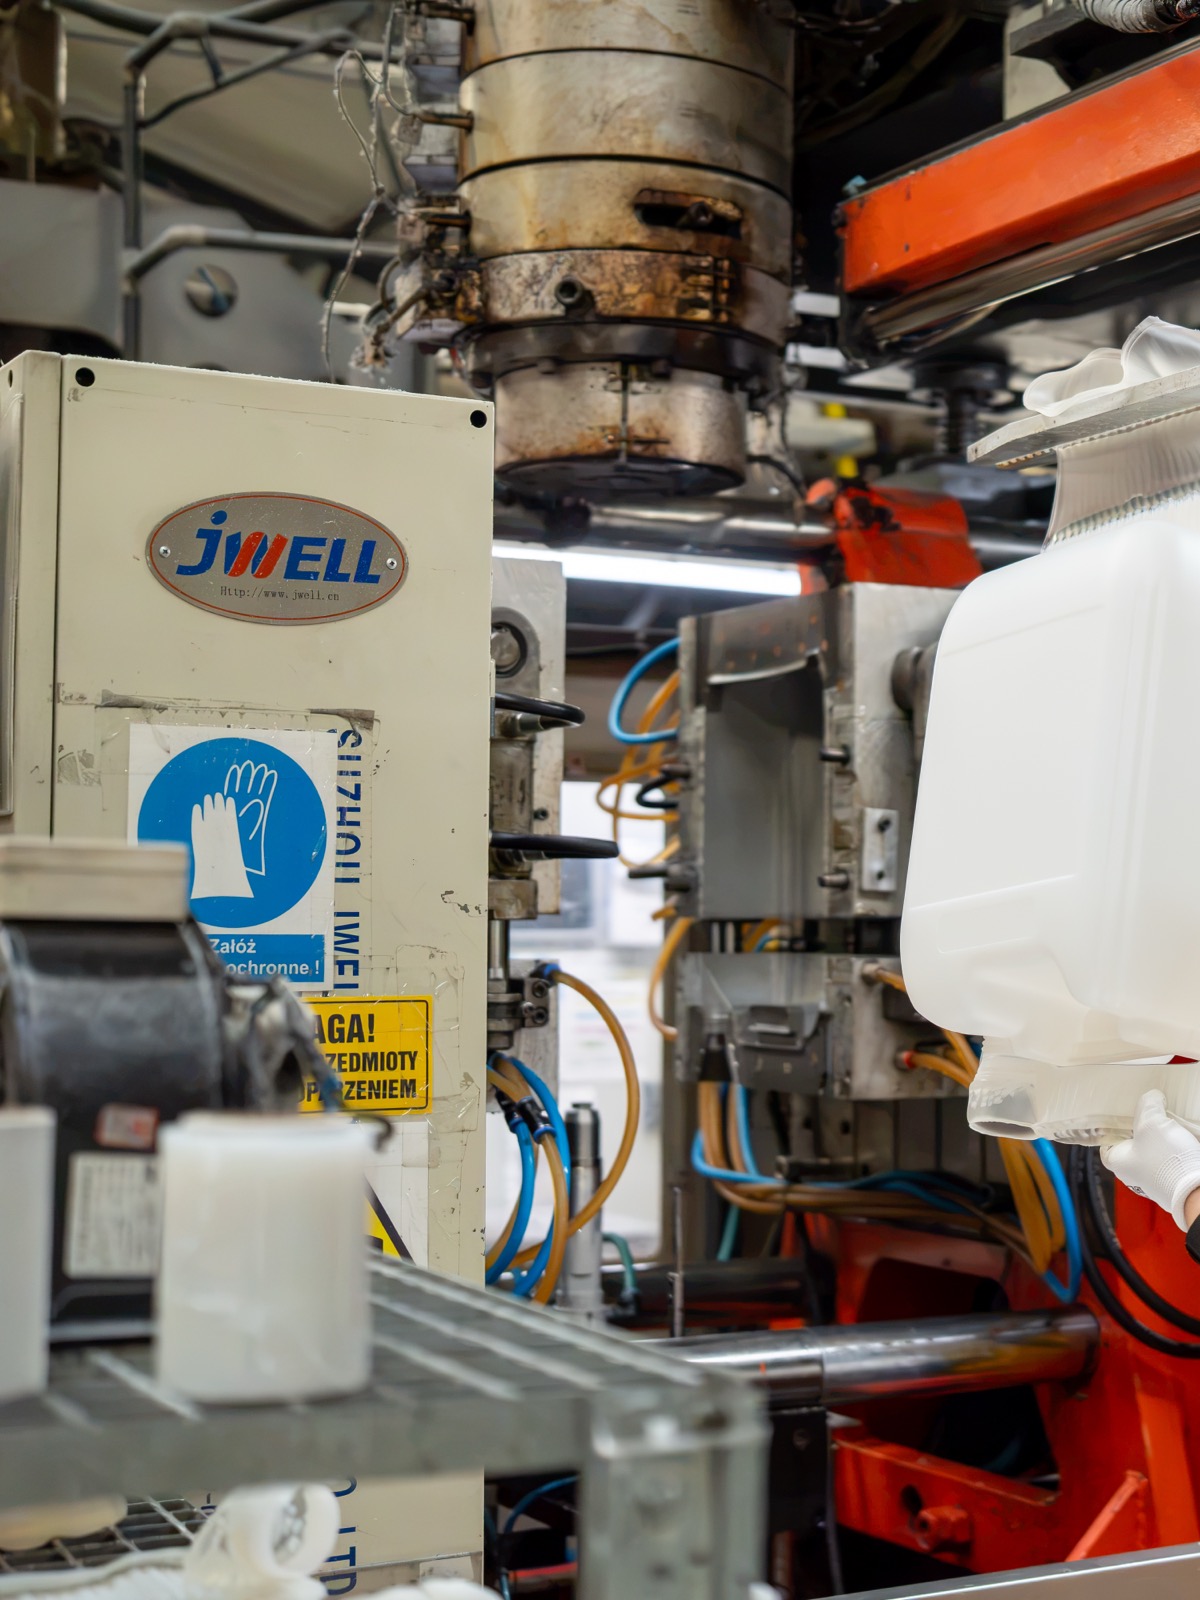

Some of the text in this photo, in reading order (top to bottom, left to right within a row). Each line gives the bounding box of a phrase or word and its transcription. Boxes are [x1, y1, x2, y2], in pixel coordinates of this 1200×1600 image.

[209, 938, 257, 954] Załóż
[314, 1013, 375, 1044] AGA!
[325, 1050, 418, 1073] ZEDMIOTY
